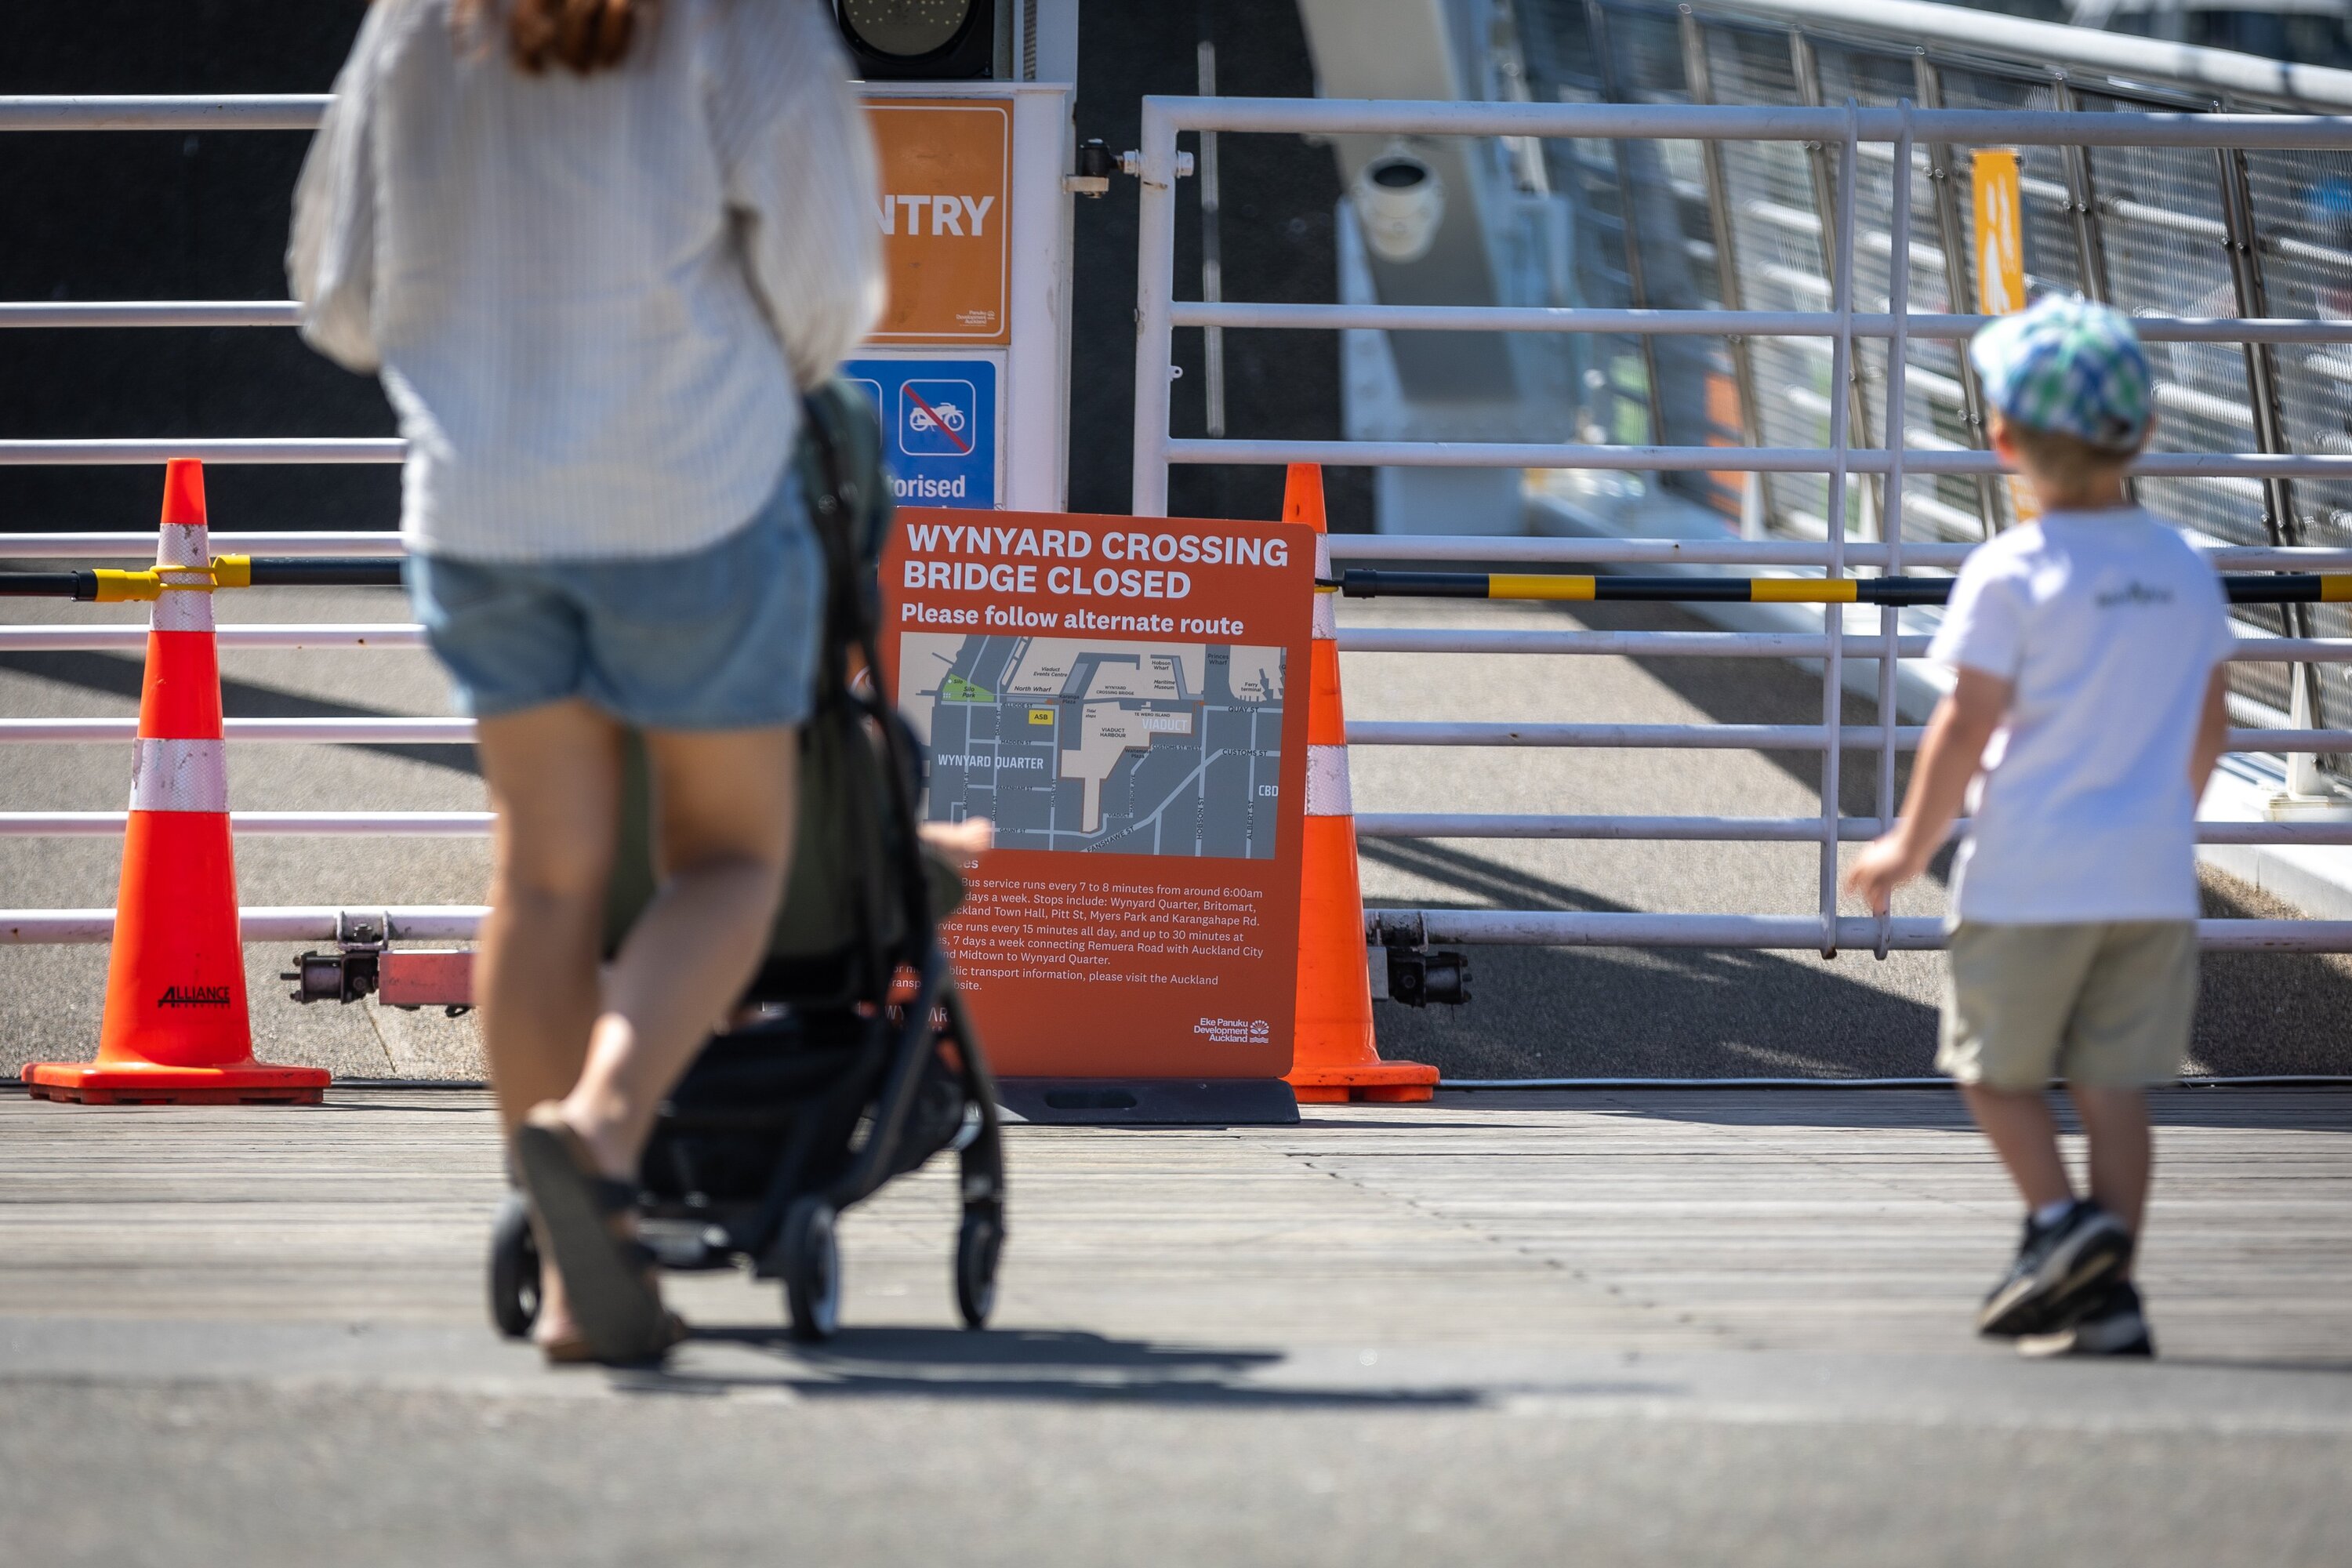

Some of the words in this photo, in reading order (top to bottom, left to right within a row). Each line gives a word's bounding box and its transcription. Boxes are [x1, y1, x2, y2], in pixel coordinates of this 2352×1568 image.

[873, 194, 995, 236] NTRY
[906, 524, 1092, 558] WYNYARD
[1102, 532, 1288, 567] CROSSING
[904, 560, 1037, 593] BRIDGE
[1047, 566, 1191, 599] CLOSED
[902, 602, 978, 624] Please
[985, 604, 1058, 628] follow
[1064, 608, 1174, 633] alternate
[1180, 617, 1244, 636] route
[1142, 718, 1188, 731] VIADUCT
[938, 754, 991, 767] WYNYARD
[995, 757, 1044, 769] QUARTER
[1258, 785, 1279, 797] CBD
[1198, 797, 1204, 805] ST
[1248, 800, 1254, 809] ST
[1087, 830, 1127, 853] FANSHAWE
[1126, 826, 1135, 834] ST
[984, 878, 1020, 889] service
[1023, 881, 1045, 890] runs
[1049, 882, 1076, 893] every
[1080, 881, 1086, 891] 7
[1089, 883, 1099, 892] to
[1102, 882, 1109, 892] 8
[1112, 883, 1153, 894] minutes
[1157, 884, 1181, 895] from
[1184, 887, 1220, 897] around
[1224, 887, 1262, 898] 6:00am
[965, 891, 989, 904] days
[1001, 893, 1030, 903] week.
[1034, 894, 1063, 906] Stops
[1067, 895, 1106, 906] include:
[1111, 897, 1155, 910] Wynyard
[1159, 898, 1200, 912] Quarter,
[1204, 901, 1256, 914] Britomart,
[994, 906, 1021, 917] Town
[1025, 908, 1047, 920] Hall,
[1052, 909, 1069, 919] Pitt
[1073, 910, 1086, 921] St,
[1091, 910, 1120, 923] Myers
[1124, 912, 1146, 922] Park
[1150, 913, 1169, 923] and
[1173, 913, 1240, 927] Karangahape
[1243, 916, 1259, 927] Rd.
[966, 924, 988, 932] runs
[992, 925, 1019, 936] every
[1023, 924, 1033, 934] 15
[1037, 924, 1077, 936] minutes
[1081, 926, 1094, 936] all
[1097, 927, 1117, 938] day,
[1121, 928, 1139, 938] and
[1143, 931, 1156, 940] up
[1160, 930, 1169, 939] to
[1173, 930, 1185, 940] 30
[1189, 931, 1230, 942] minutes
[1233, 933, 1243, 942] at
[953, 935, 960, 946] 7
[963, 935, 986, 949] days
[989, 938, 995, 947] a
[999, 938, 1024, 948] week
[1028, 939, 1085, 953] connecting
[1088, 940, 1134, 952] Remuera
[1138, 942, 1163, 953] Road
[1167, 944, 1188, 954] with
[1192, 945, 1240, 956] Auckland
[1243, 946, 1263, 959] City
[944, 949, 956, 959] nd
[960, 949, 1003, 960] Midtown
[1007, 952, 1017, 962] to
[1021, 952, 1065, 964] Wynyard
[1069, 953, 1110, 966] Quarter.
[971, 967, 1019, 979] transport
[1023, 967, 1085, 982] information,
[1090, 971, 1123, 982] please
[1126, 972, 1147, 982] visit
[1150, 974, 1167, 983] the
[1171, 975, 1218, 985] Auckland
[158, 986, 230, 1007] ALLIANCE
[1194, 1025, 1248, 1035] Development
[1200, 1018, 1216, 1026] Eke
[1218, 1018, 1248, 1027] Panuku
[1209, 1034, 1248, 1043] Auckland
